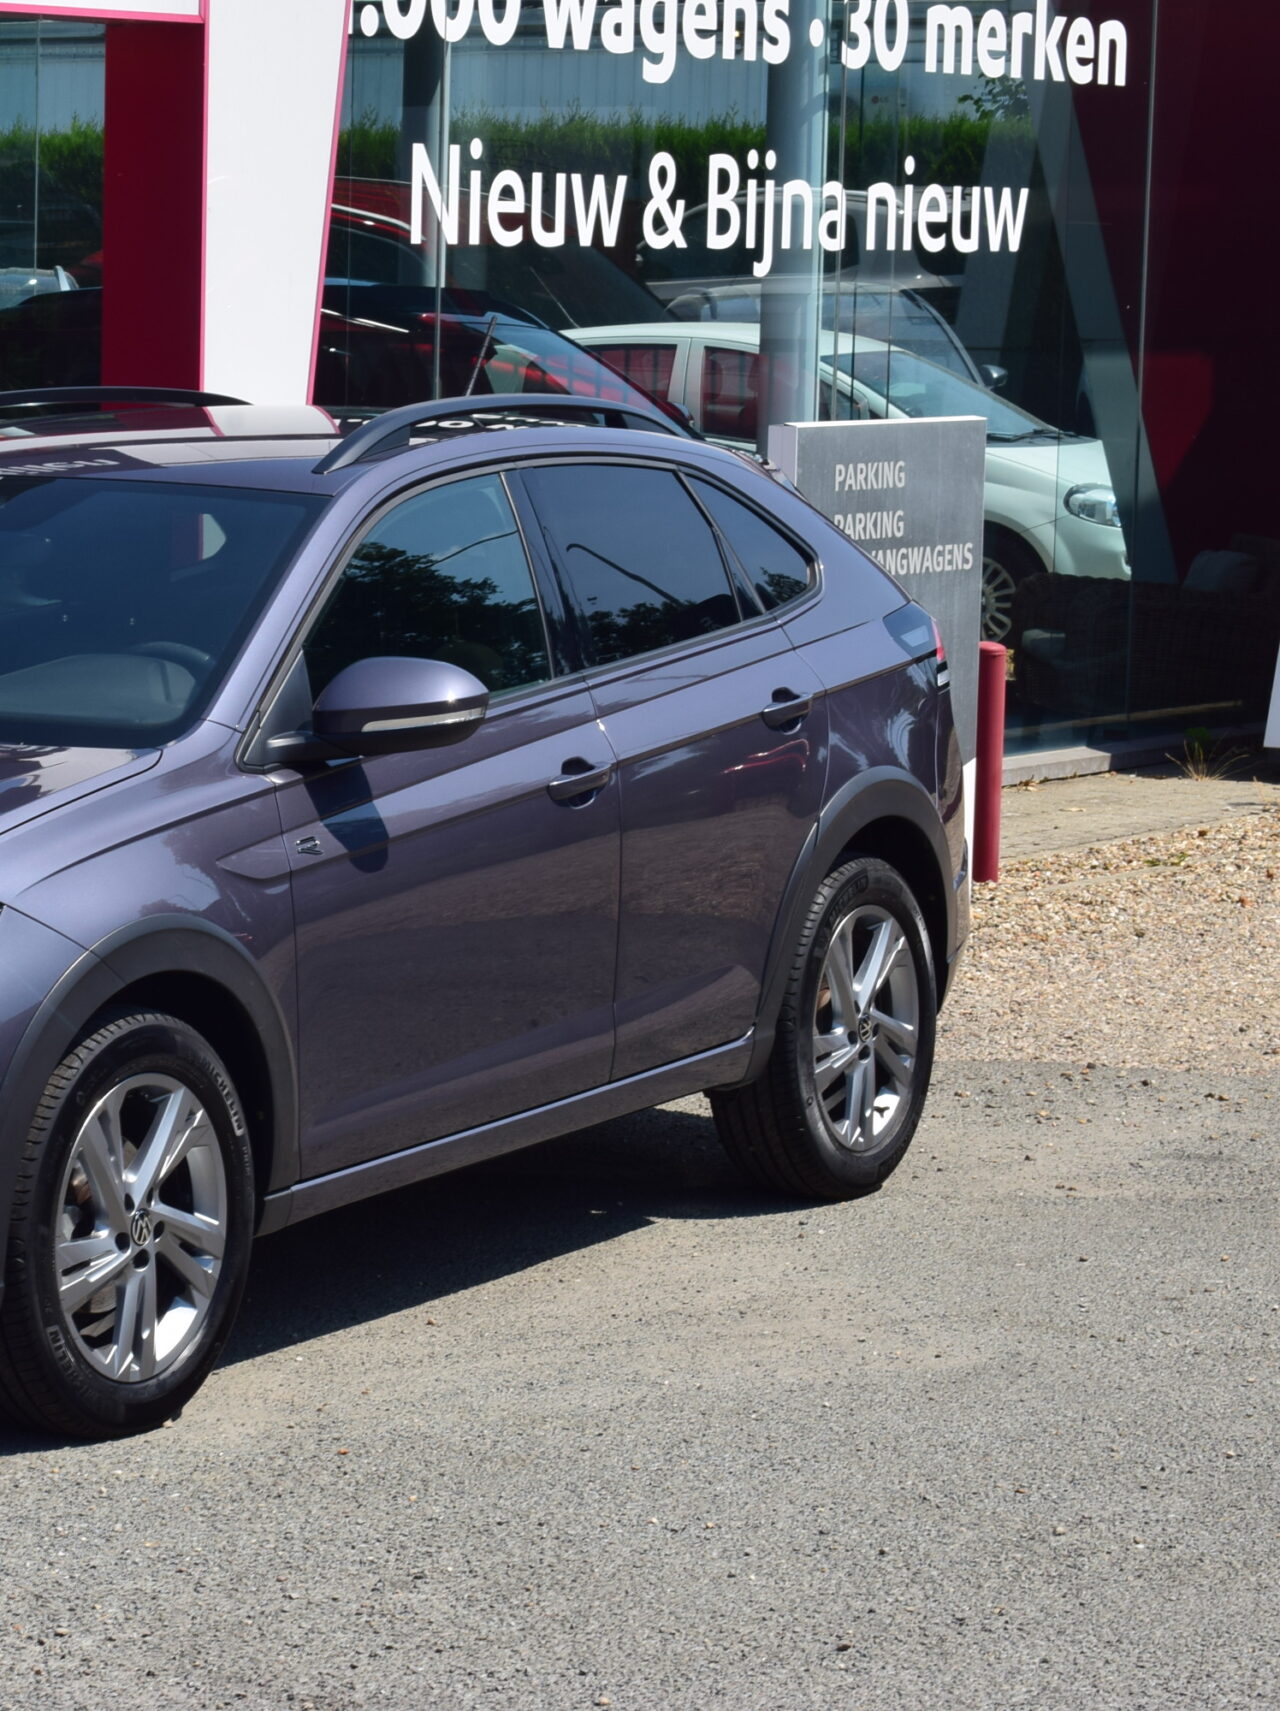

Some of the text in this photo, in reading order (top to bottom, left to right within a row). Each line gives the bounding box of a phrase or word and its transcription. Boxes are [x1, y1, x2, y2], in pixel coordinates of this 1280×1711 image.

[542, 0, 790, 84] wagens
[841, 0, 909, 72] 30
[925, 0, 1127, 87] merken
[410, 137, 1029, 278] Nieuw & Bijna nieuw
[835, 461, 905, 491] PARKING
